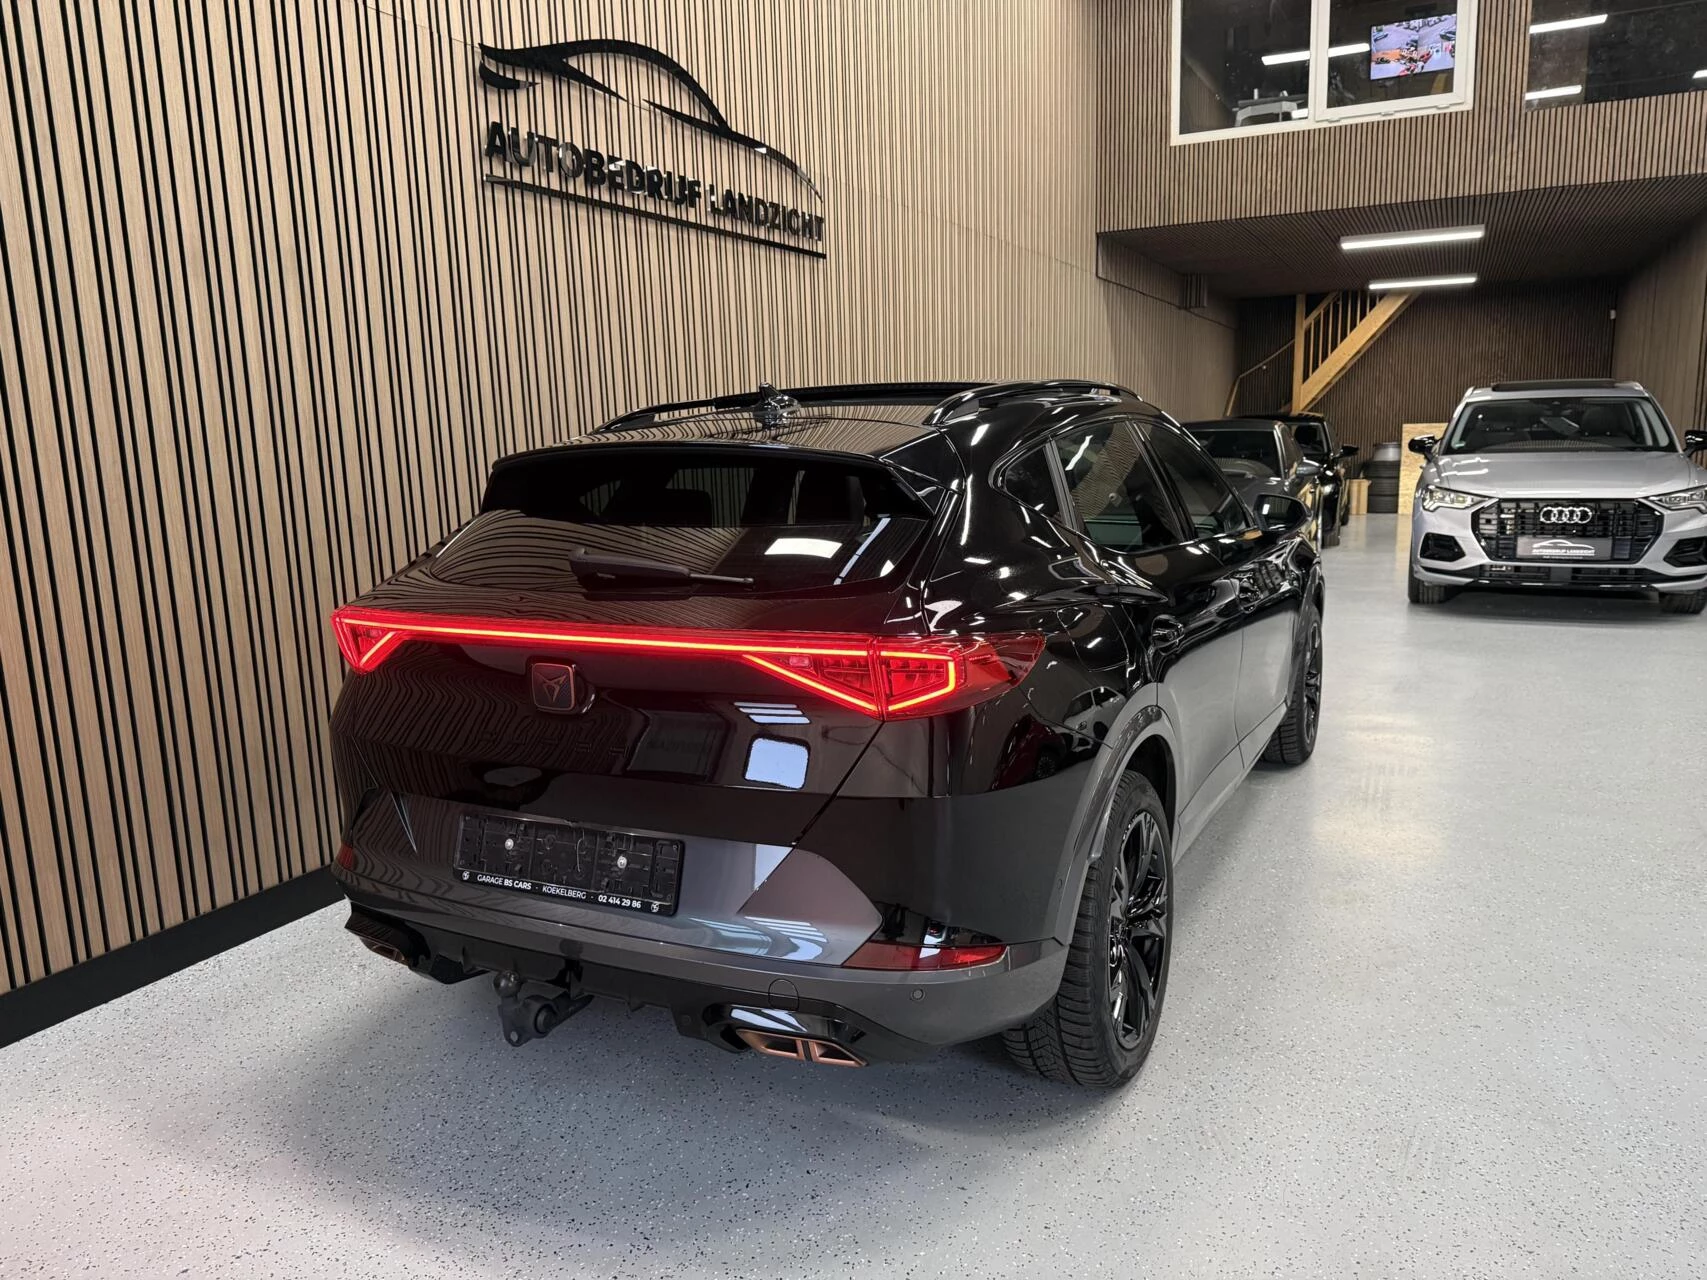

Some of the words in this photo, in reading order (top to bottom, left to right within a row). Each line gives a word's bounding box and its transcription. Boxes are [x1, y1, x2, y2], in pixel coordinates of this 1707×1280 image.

[484, 121, 702, 208] AUTOBEDRIJF
[706, 183, 824, 242] LANDZICHT
[477, 874, 503, 885] GARAGE
[503, 878, 513, 887] BS
[513, 880, 532, 890] CARS
[542, 885, 587, 899] KOEKELBERG
[597, 894, 608, 903] 02
[608, 896, 621, 905] 414
[621, 898, 631, 907] 29
[631, 900, 642, 909] 86
